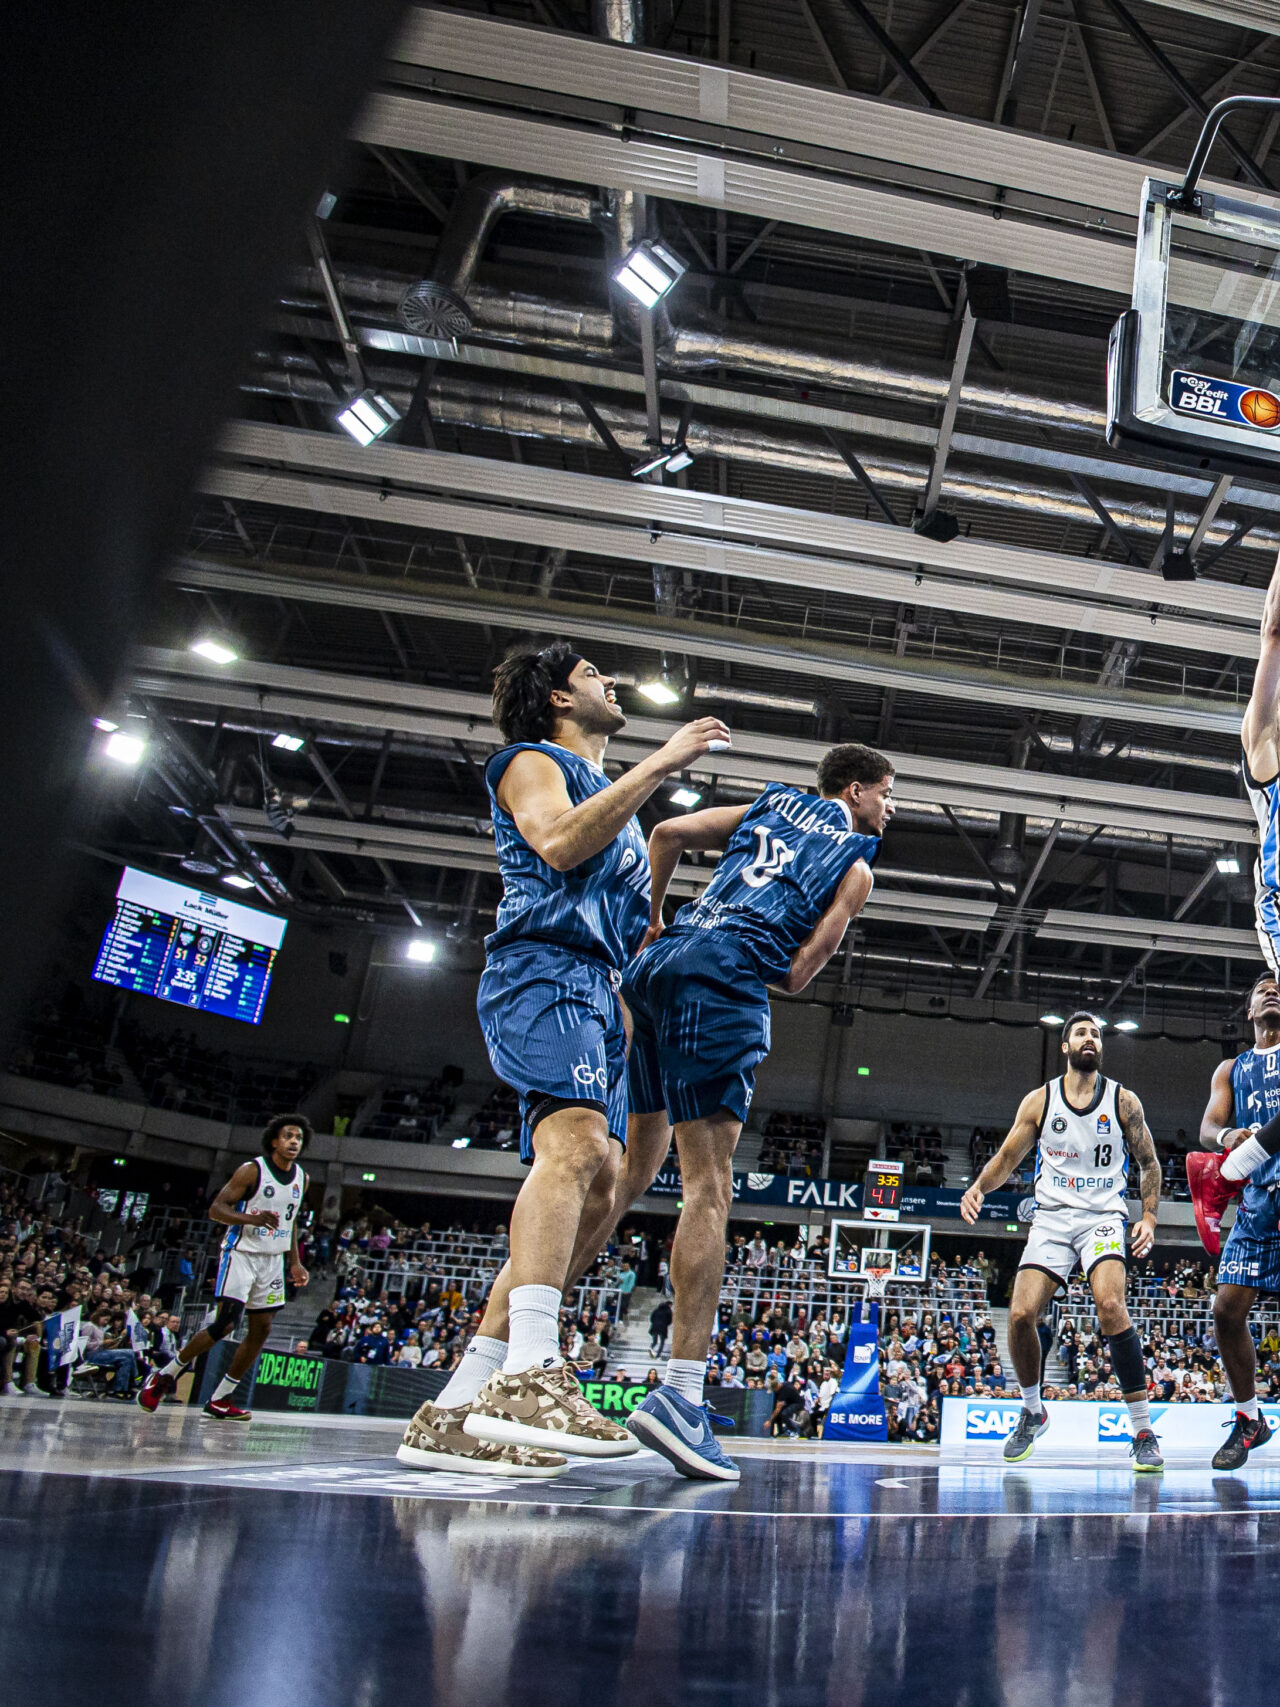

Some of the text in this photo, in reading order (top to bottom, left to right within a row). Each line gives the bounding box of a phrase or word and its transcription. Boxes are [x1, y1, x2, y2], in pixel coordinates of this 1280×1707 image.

[1194, 385, 1229, 401] Credit
[1178, 391, 1227, 416] BBL
[174, 947, 208, 967] 51 52
[174, 967, 197, 983] 3:35
[1266, 1053, 1277, 1072] 0
[1053, 1150, 1079, 1159] VEOLIA
[1094, 1143, 1112, 1168] 13
[787, 1179, 859, 1208] FALK
[1053, 1175, 1114, 1193] nexperia
[252, 1226, 291, 1240] nexper
[831, 1412, 883, 1426] BE MORE
[967, 1409, 1019, 1436] SAP
[1099, 1412, 1133, 1438] SA
